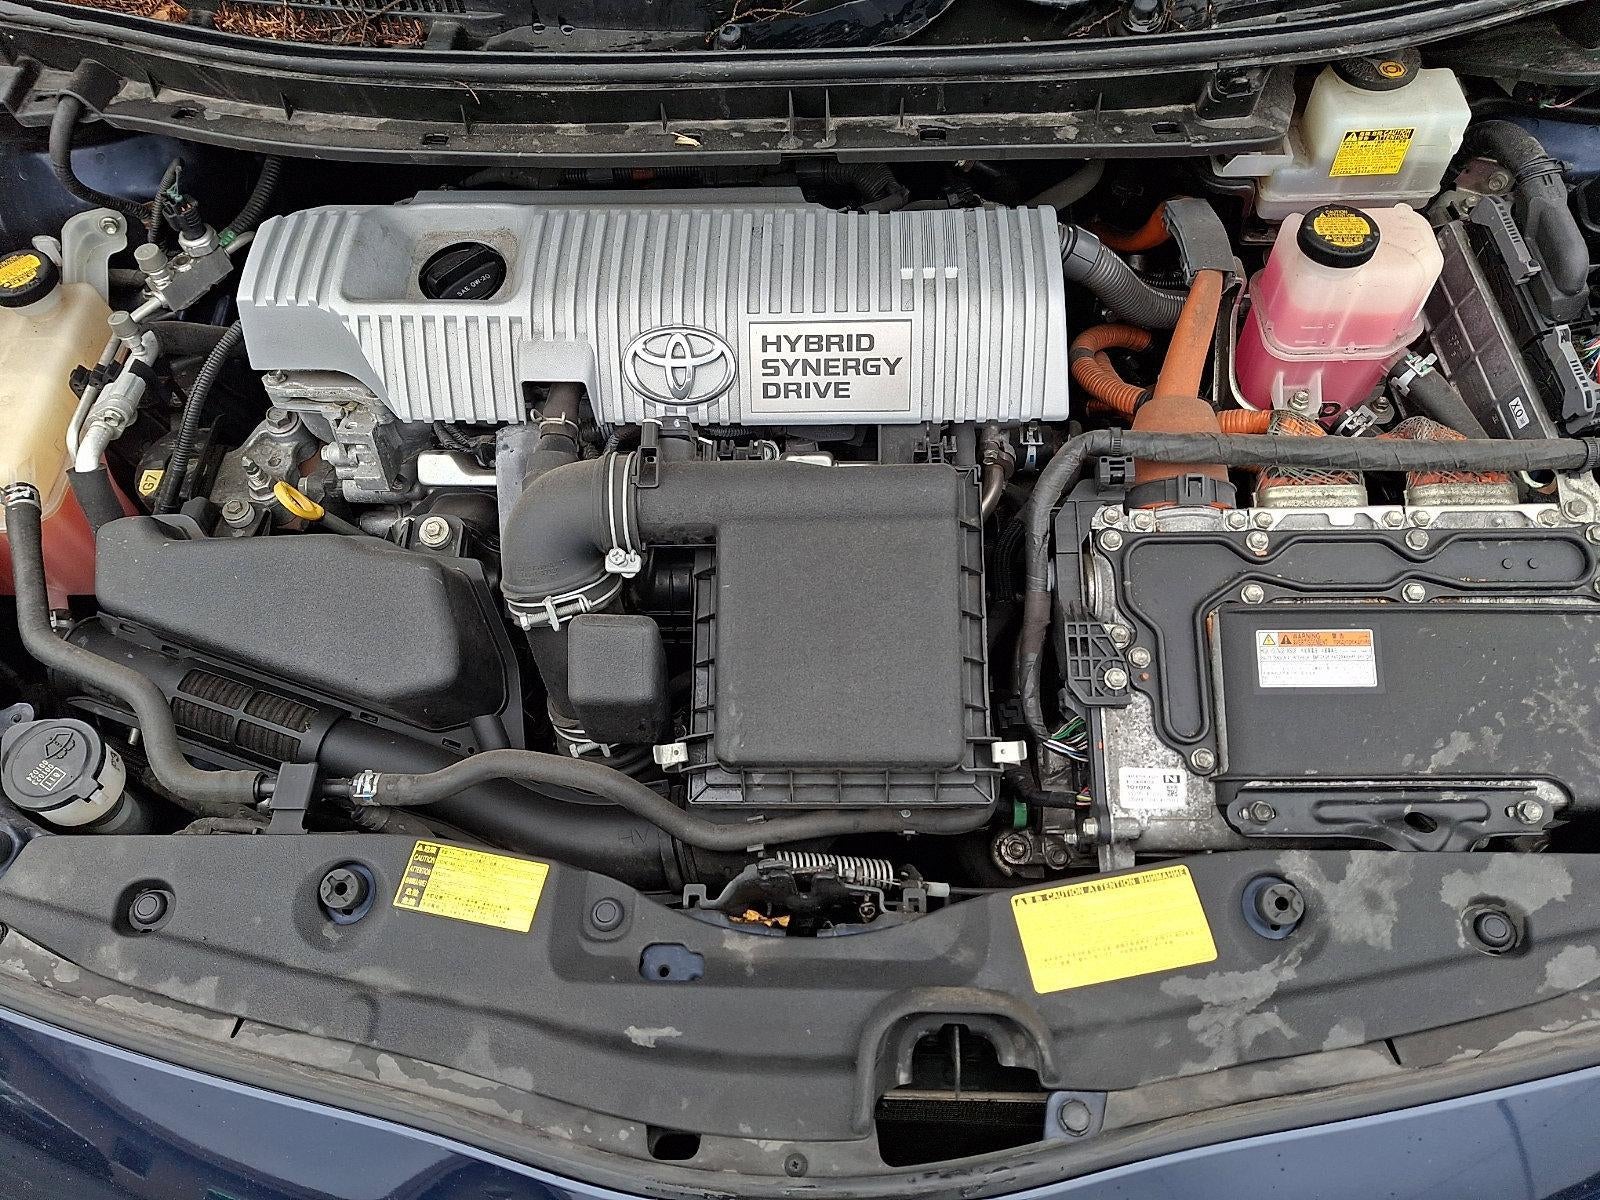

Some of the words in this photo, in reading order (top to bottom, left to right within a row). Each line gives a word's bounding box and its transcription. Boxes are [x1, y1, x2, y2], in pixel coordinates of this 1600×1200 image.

[457, 285, 471, 297] SAE
[761, 333, 875, 353] HYBRID
[761, 356, 903, 376] SYNERGY
[762, 381, 851, 399] DRIVE
[142, 474, 157, 491] G7
[413, 853, 436, 864] CAUTION
